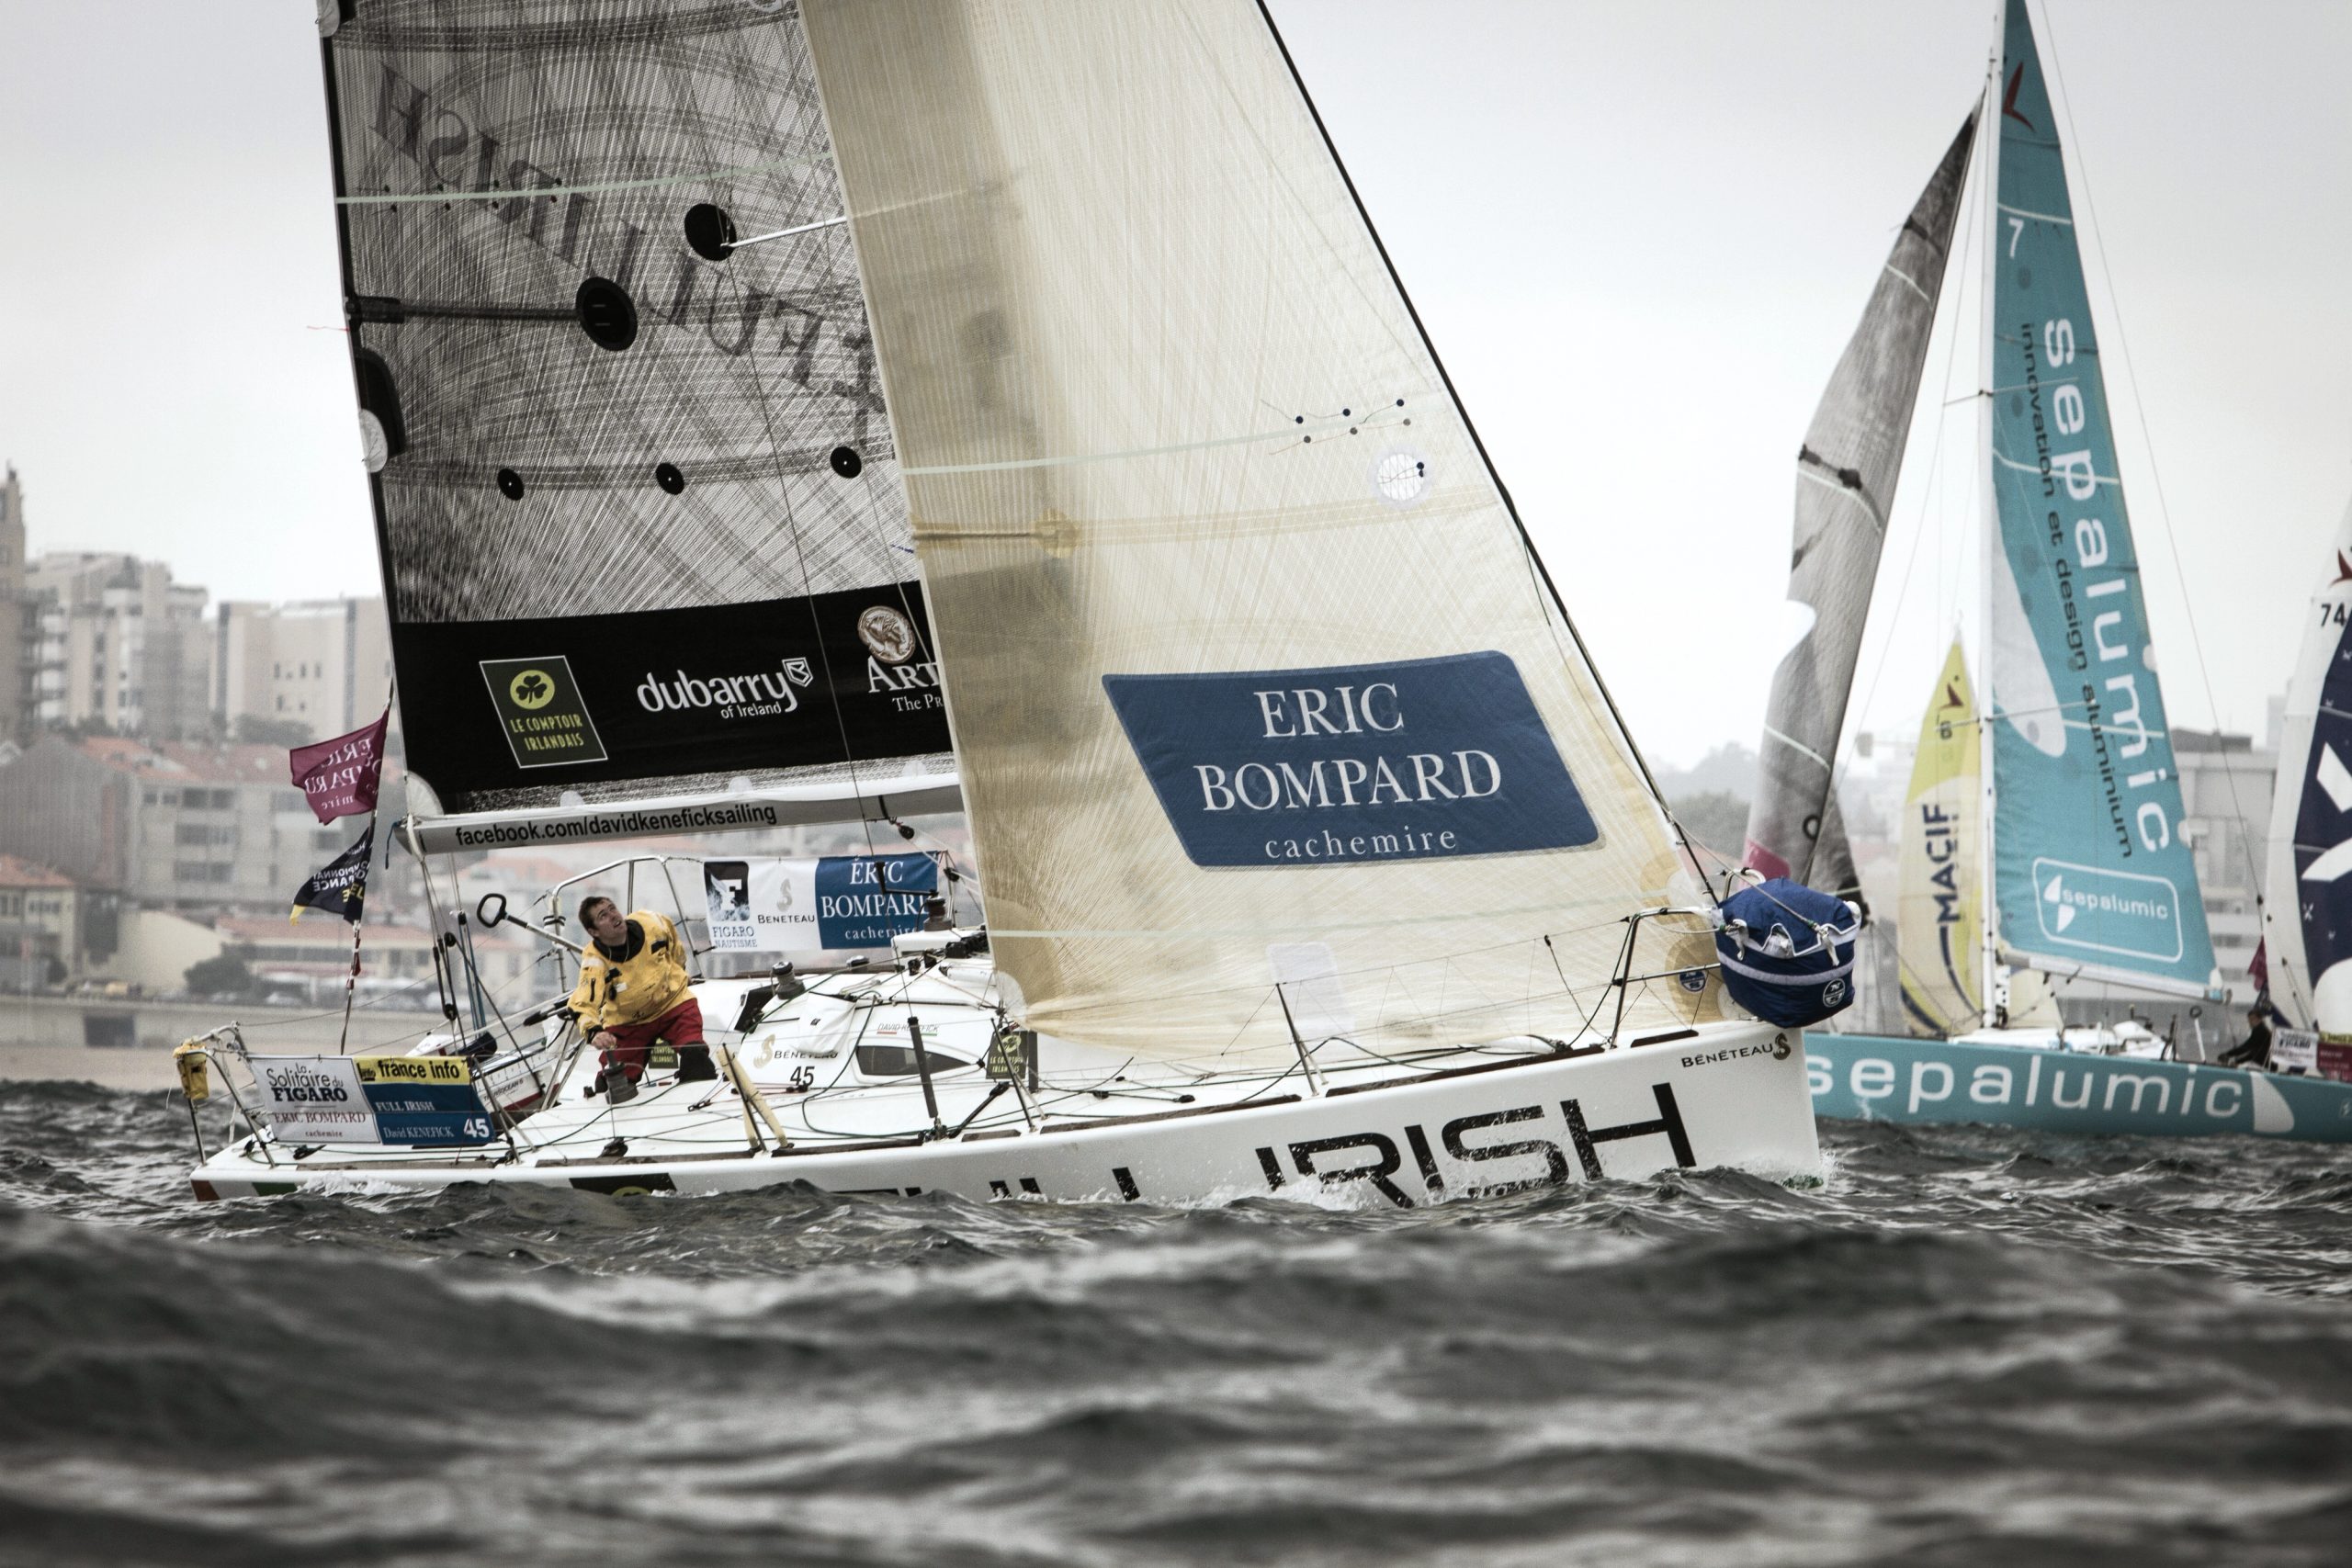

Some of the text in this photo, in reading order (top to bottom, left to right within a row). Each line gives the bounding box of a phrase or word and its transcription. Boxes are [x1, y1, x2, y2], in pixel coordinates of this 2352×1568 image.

[2008, 217, 2024, 258] 7
[2021, 322, 2132, 859] innovation et design aluminium
[2044, 319, 2170, 852] sepalumic
[2321, 602, 2347, 627] 74
[867, 655, 940, 694] ART
[637, 669, 797, 713] dubarry
[720, 702, 782, 719] of Ireland
[891, 694, 944, 712] The PR
[1253, 682, 1404, 738] ERIC
[510, 713, 583, 733] LE COMPTOIR
[524, 732, 584, 751] IRLANDAIS
[1193, 750, 1501, 811] BOMPARD
[455, 804, 777, 846] facebook.com/davidkeneficksailing
[1265, 825, 1456, 859] cachemire
[1923, 804, 1961, 922] MACIF
[2062, 886, 2169, 920] sepalumic
[757, 914, 815, 924] BENETEAU
[712, 926, 754, 938] FIGARO
[715, 939, 758, 948] NAUTISME
[266, 1066, 344, 1088] Solitaire du
[295, 1062, 308, 1075] La
[378, 1060, 427, 1079] france
[428, 1060, 460, 1079] info
[790, 1066, 815, 1087] 45
[271, 1086, 348, 1102] FIGARO
[1806, 1055, 2242, 1119] sepalumic
[375, 1101, 435, 1111] FULL IRISH
[305, 1111, 367, 1123] BOMPARD
[383, 1126, 455, 1138] David KENEFICK
[463, 1118, 490, 1138] 45
